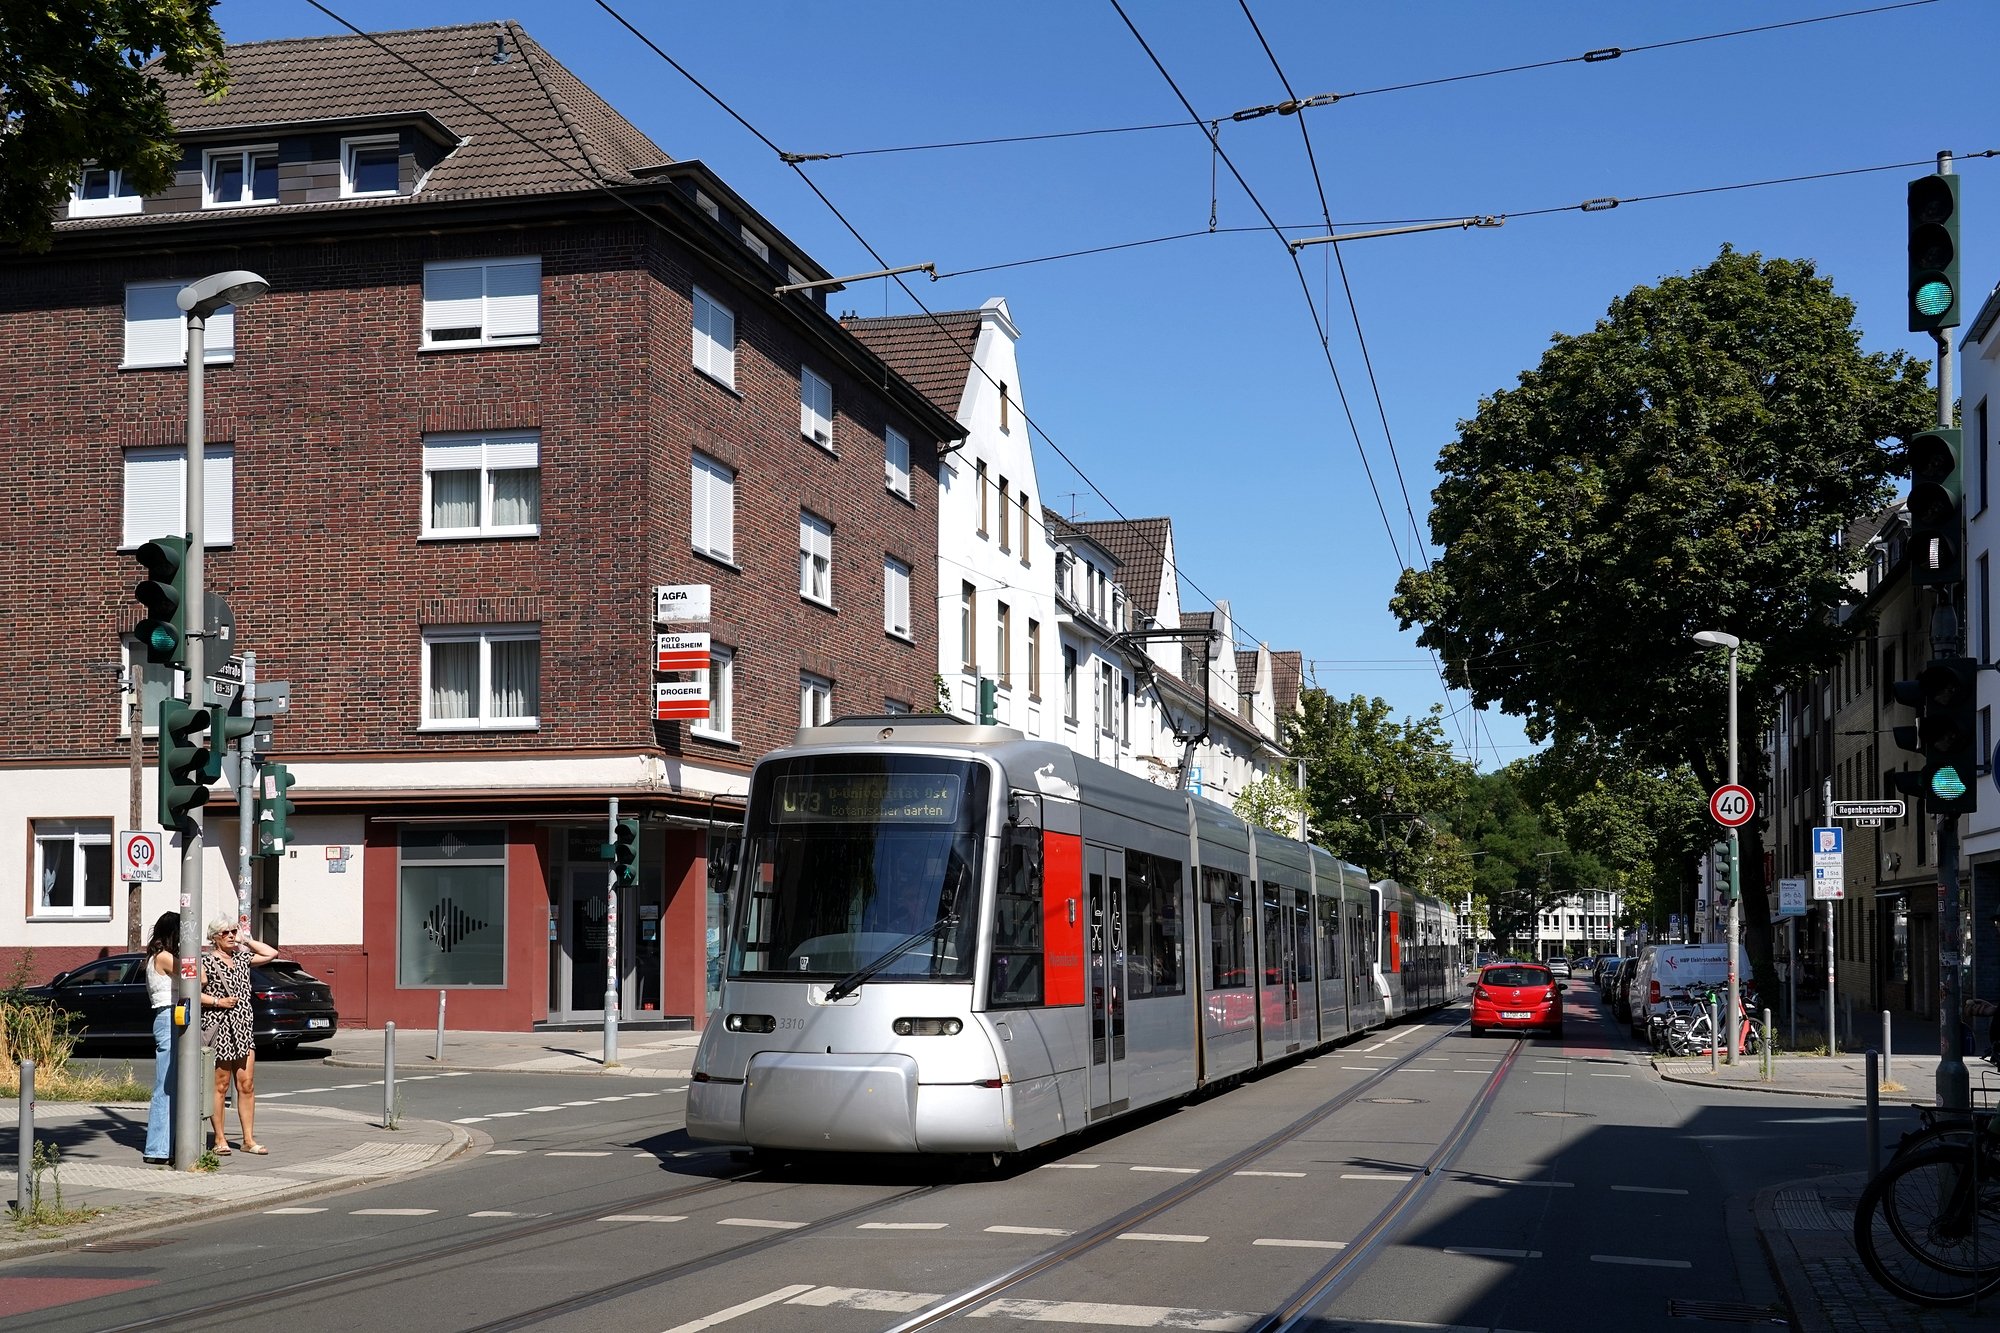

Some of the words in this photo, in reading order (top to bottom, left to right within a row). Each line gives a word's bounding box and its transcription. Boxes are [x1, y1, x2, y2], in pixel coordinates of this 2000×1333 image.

[661, 591, 688, 601] AGFA
[661, 642, 703, 650] HILLESHEIM
[660, 688, 702, 696] DROGERIE
[924, 787, 948, 799] Ost
[783, 791, 821, 812] U73
[1720, 796, 1746, 815] 40
[831, 804, 899, 817] Botanischer
[903, 804, 943, 817] Garten
[1839, 805, 1898, 816] Regenbergastraße
[133, 844, 149, 859] 30
[779, 1017, 805, 1030] 3310
